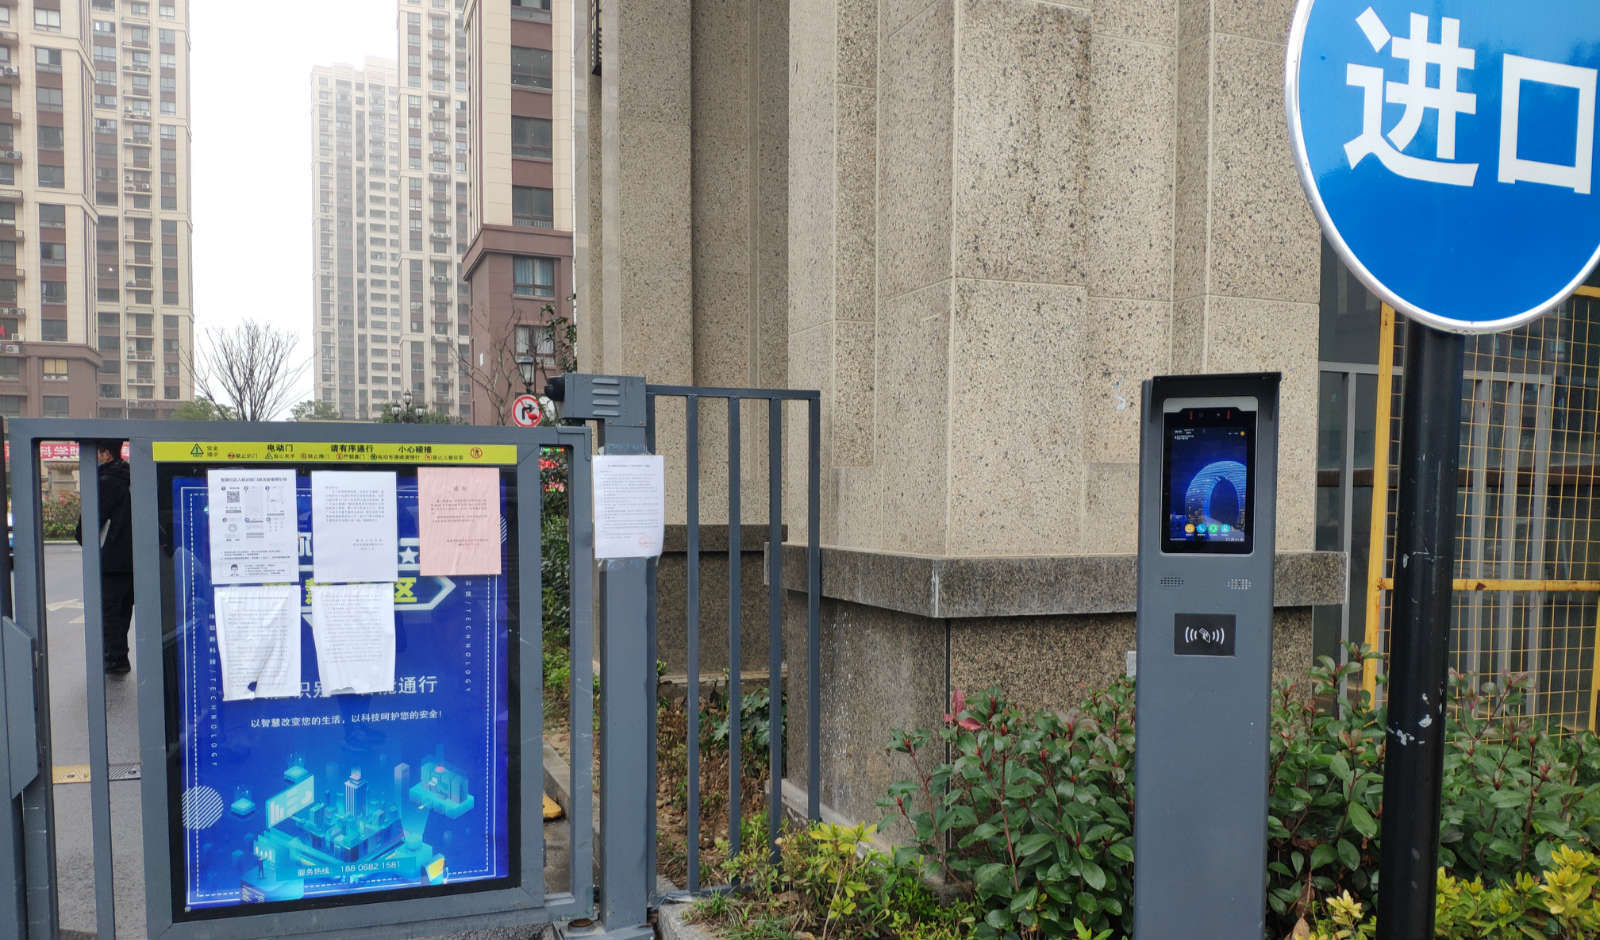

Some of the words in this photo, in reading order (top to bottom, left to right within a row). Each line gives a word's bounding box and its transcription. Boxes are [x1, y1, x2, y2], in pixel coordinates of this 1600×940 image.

[1343, 6, 1598, 195] 进口
[267, 444, 294, 453] 电动门
[331, 445, 374, 453] 请有序通行
